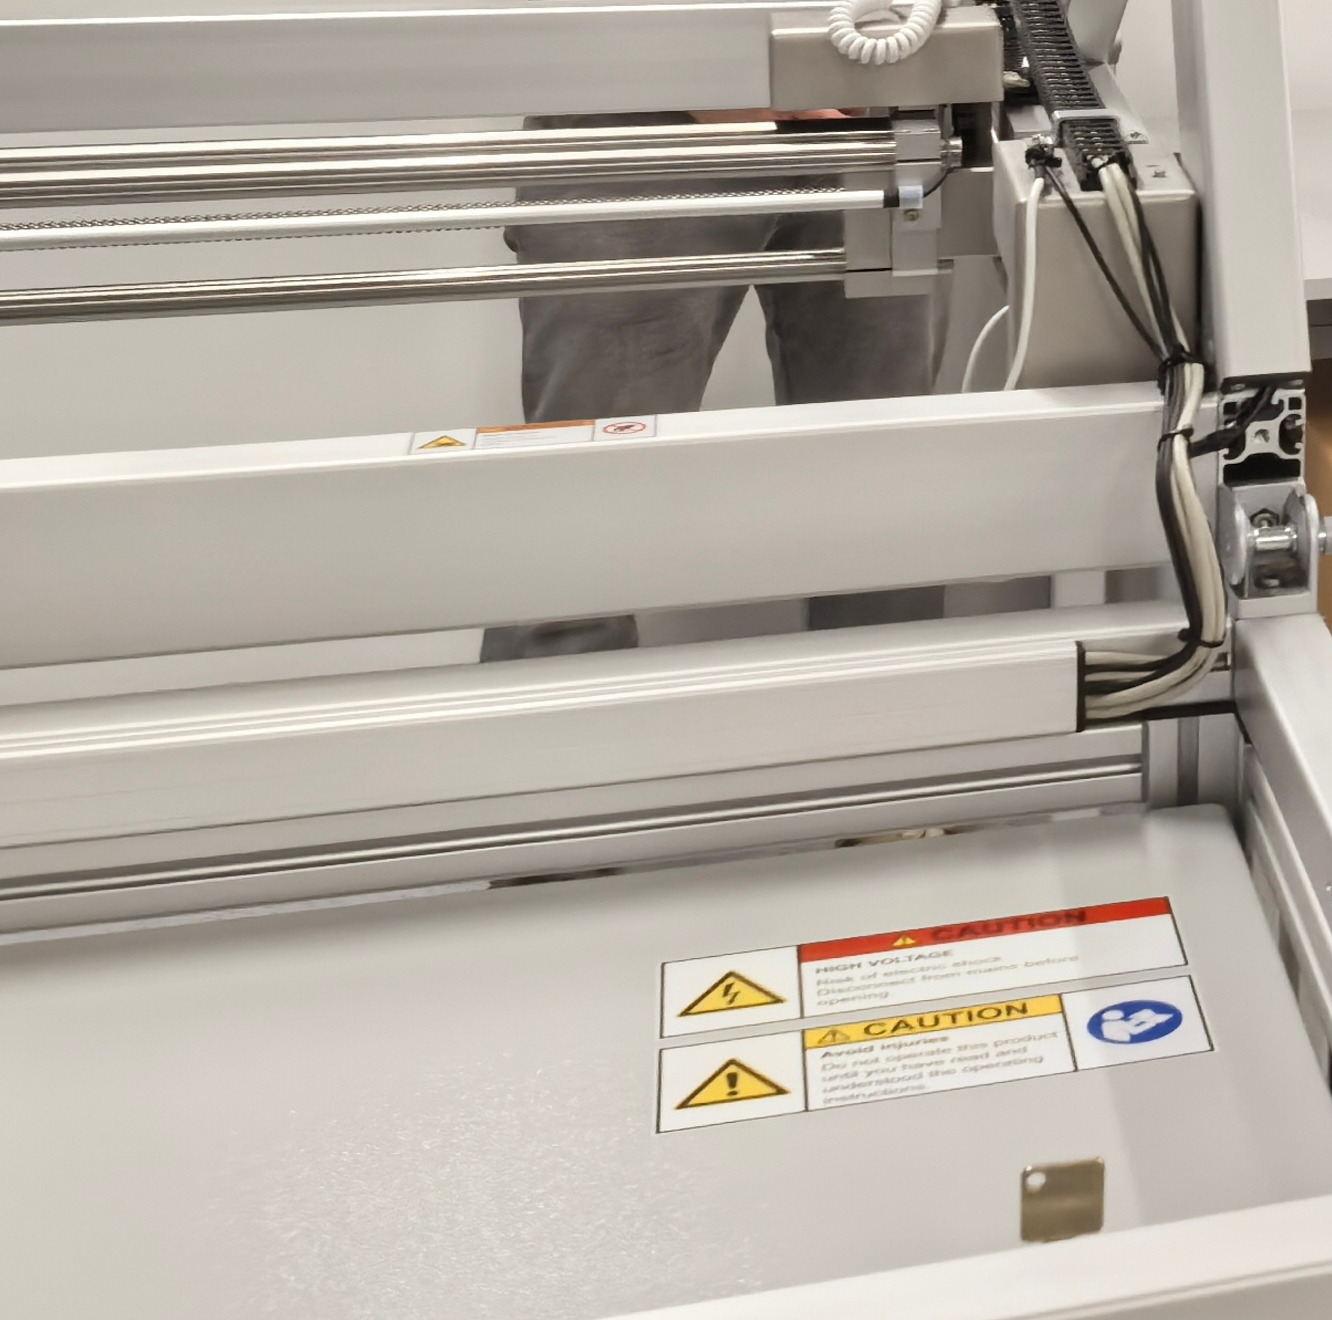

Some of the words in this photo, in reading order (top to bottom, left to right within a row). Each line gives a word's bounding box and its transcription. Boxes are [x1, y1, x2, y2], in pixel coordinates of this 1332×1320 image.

[932, 910, 1087, 941] CAUTION
[815, 961, 862, 974] HIGH
[868, 949, 954, 967] VOLTAGE
[816, 976, 915, 997] Disconnect
[920, 970, 961, 983] from
[1024, 954, 1079, 968] before
[860, 971, 878, 981] of
[882, 964, 947, 978] electric
[951, 955, 1001, 968] shock
[863, 1002, 1029, 1036] CAUTION
[820, 1045, 874, 1059] Avoid
[880, 1036, 949, 1051] injuries
[885, 1047, 952, 1063] operate
[993, 1031, 1059, 1048] product
[961, 1055, 1044, 1073] operating
